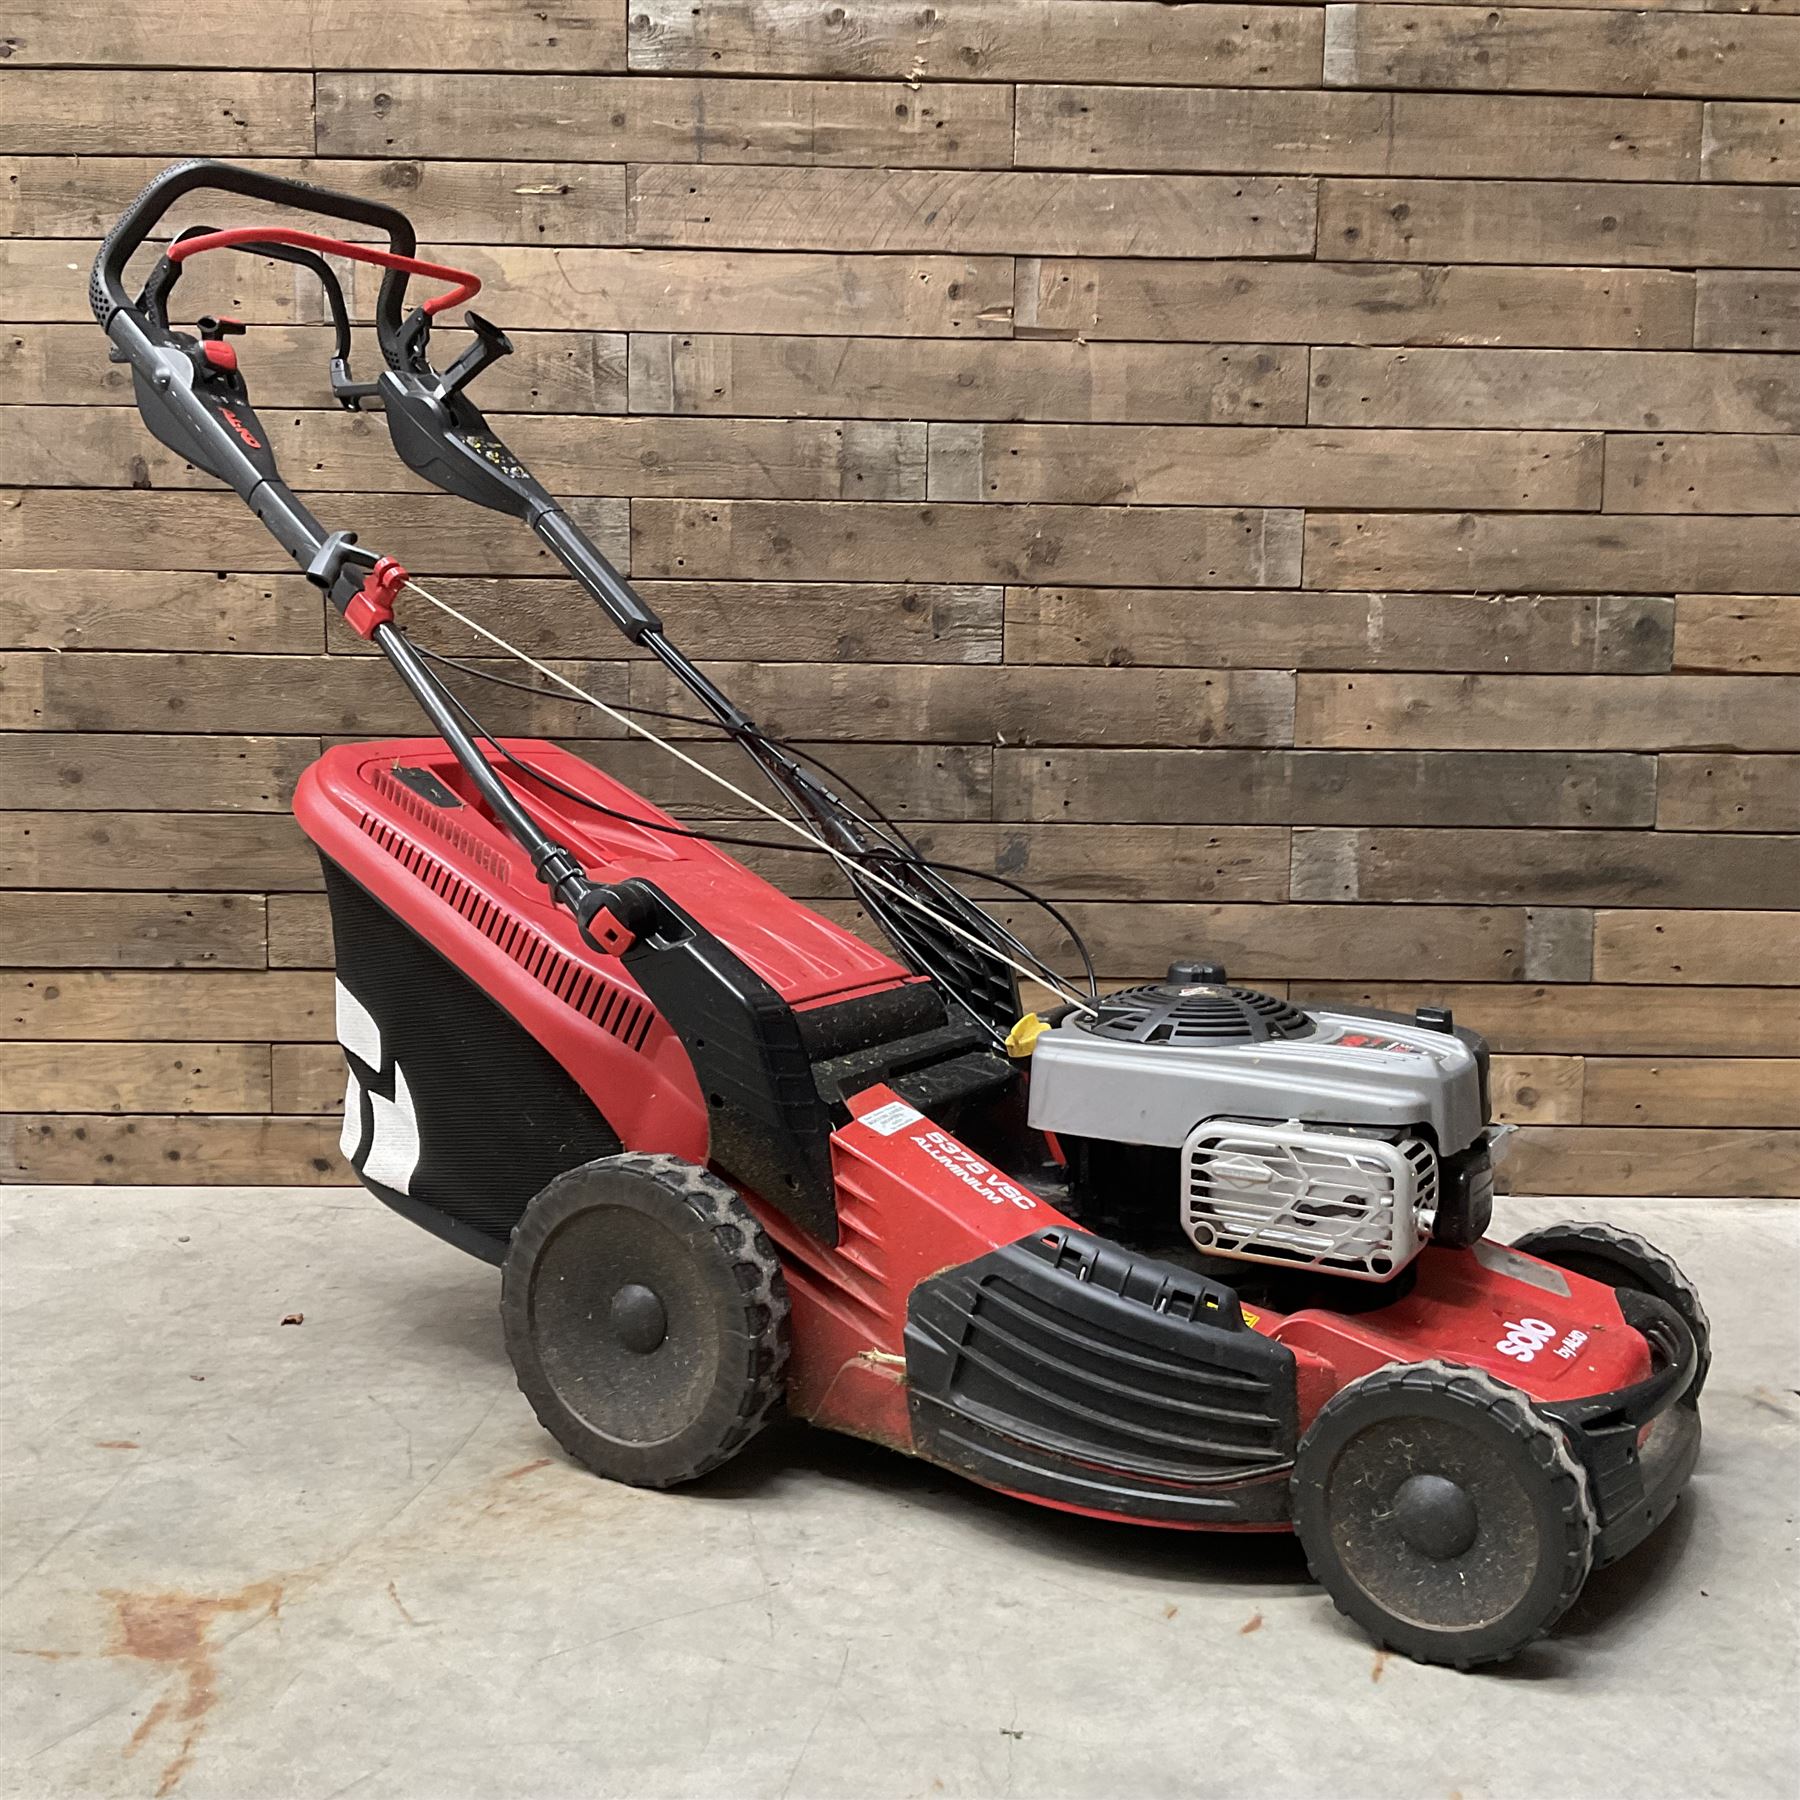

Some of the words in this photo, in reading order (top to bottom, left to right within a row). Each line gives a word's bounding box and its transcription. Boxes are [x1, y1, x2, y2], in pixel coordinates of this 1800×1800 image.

[910, 1135, 1005, 1205] ALUMINIUM
[925, 1131, 989, 1175] 5375
[985, 1173, 1037, 1210] VSC
[1496, 1318, 1557, 1362] solo
[1552, 1345, 1577, 1360] by
